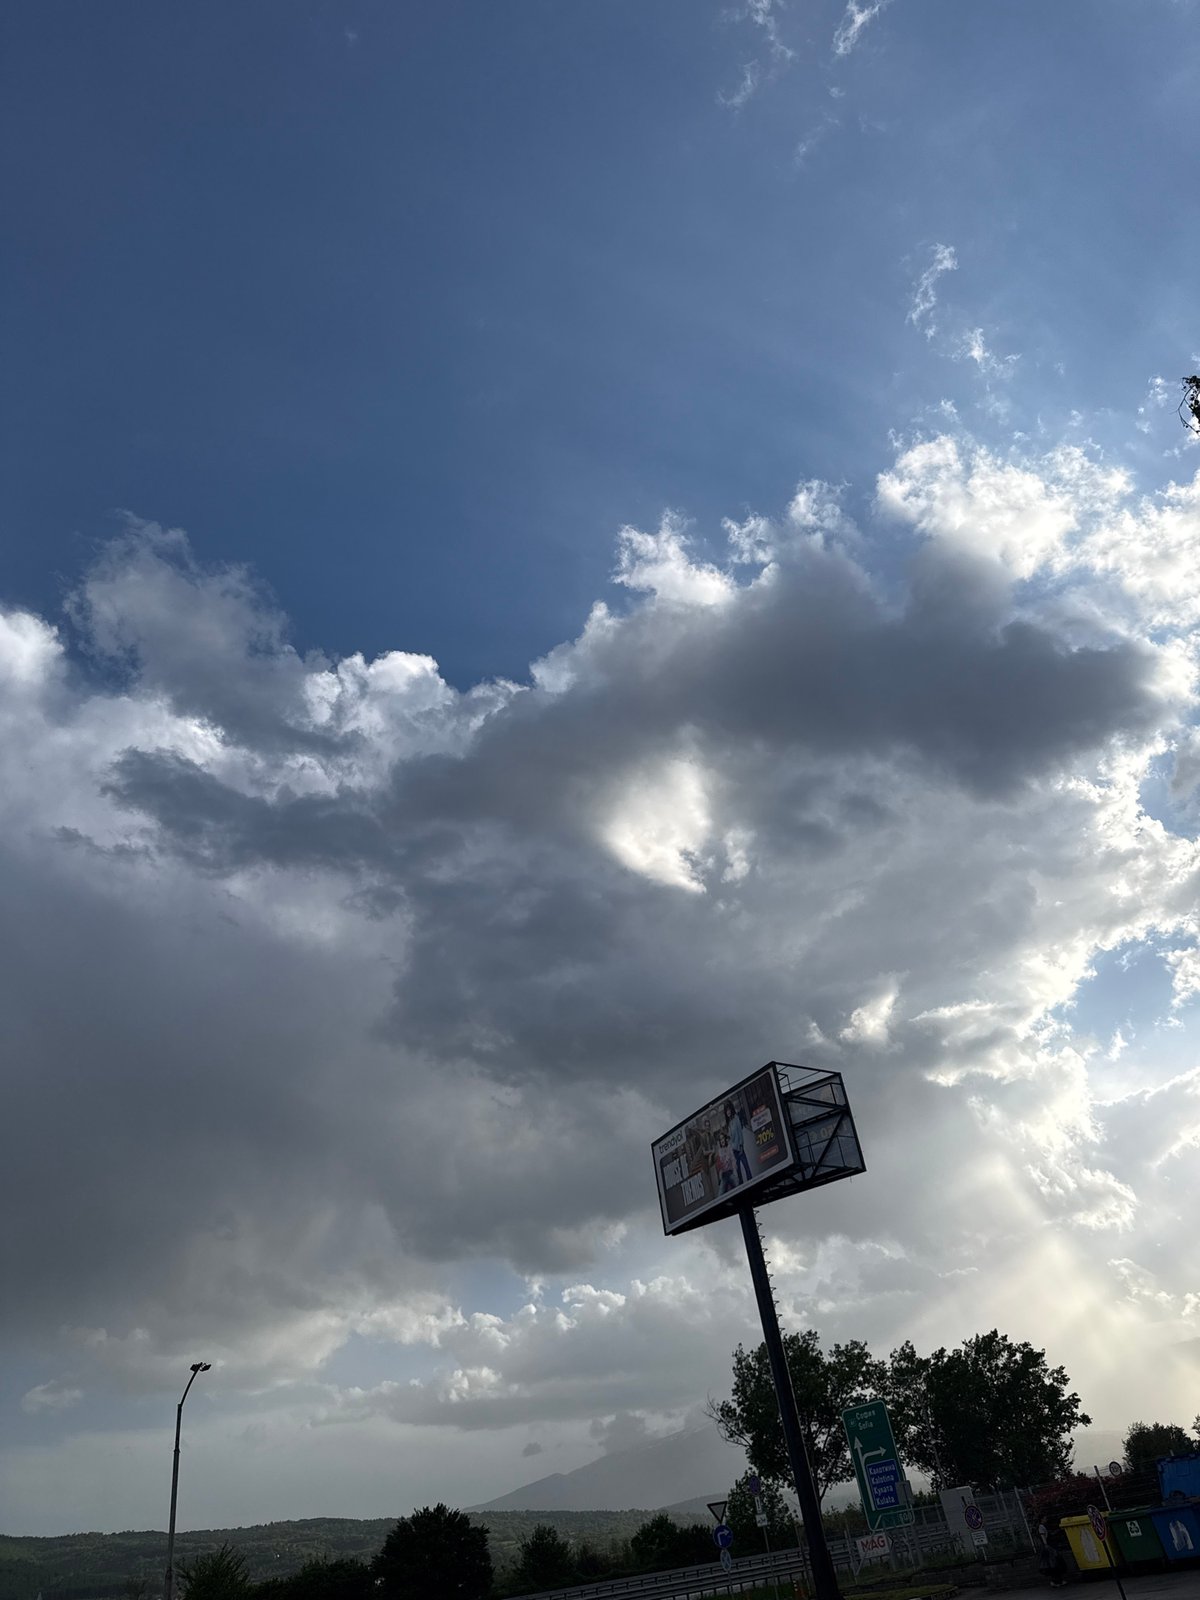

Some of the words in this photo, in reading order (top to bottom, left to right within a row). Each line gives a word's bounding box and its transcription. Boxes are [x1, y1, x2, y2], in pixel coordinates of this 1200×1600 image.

[659, 1132, 683, 1154] trendyol
[876, 1495, 895, 1505] Kulata
[861, 1536, 886, 1553] MAG
